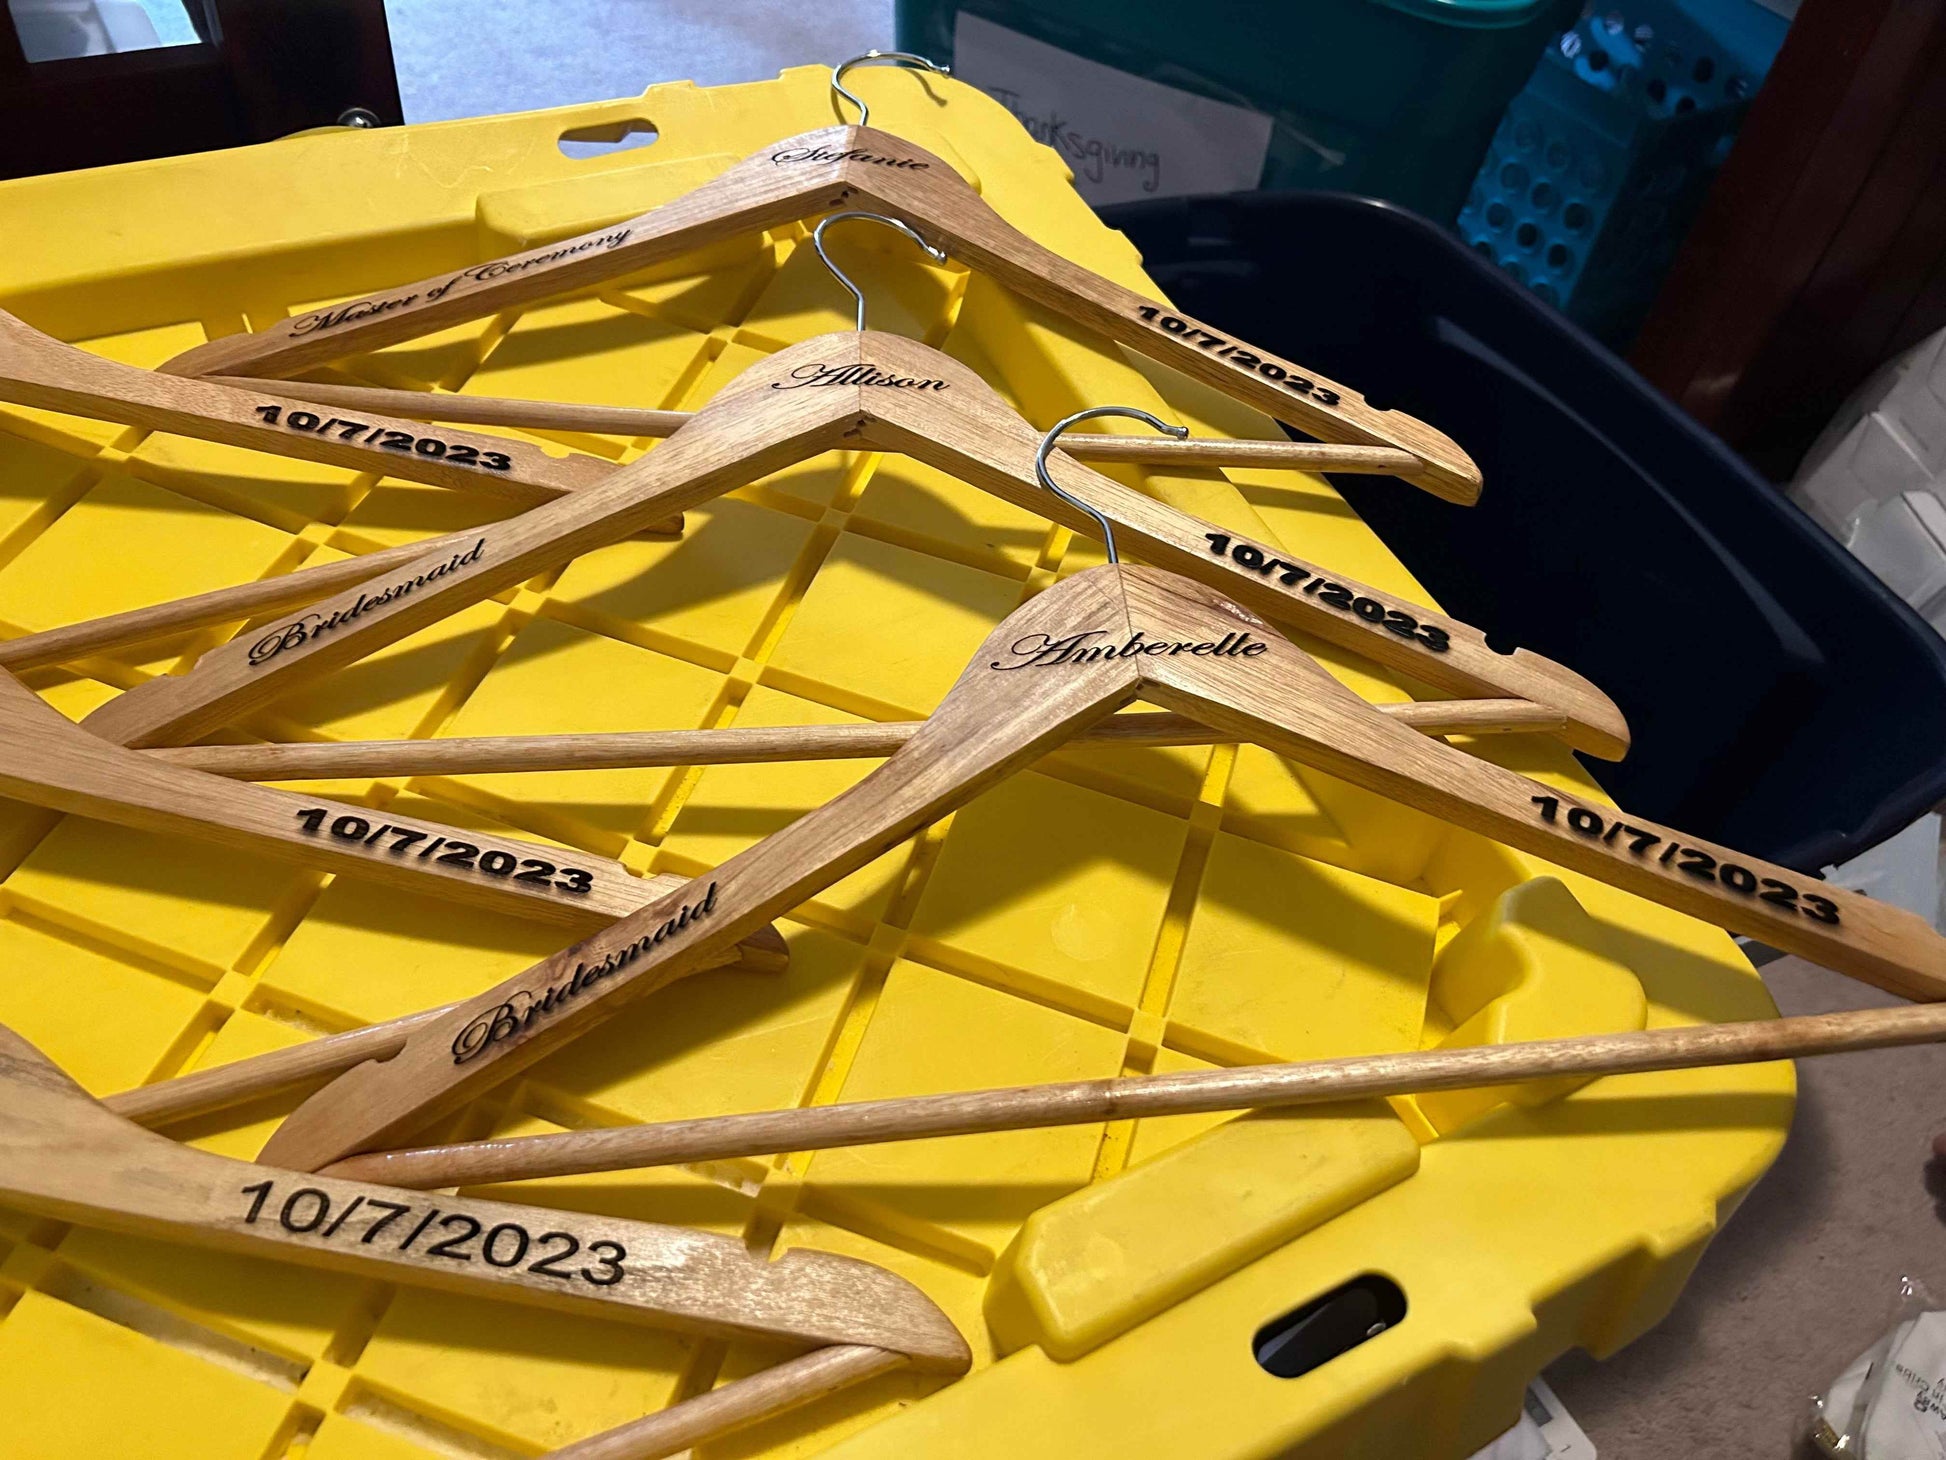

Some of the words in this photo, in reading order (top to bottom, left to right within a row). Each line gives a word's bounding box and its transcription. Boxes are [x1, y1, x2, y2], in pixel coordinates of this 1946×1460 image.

[772, 144, 930, 172] Stefanie
[288, 291, 419, 338] Master
[426, 274, 462, 302] of
[463, 226, 634, 282] Ceremony
[771, 363, 950, 392] Allison
[1138, 305, 1341, 407] 10/7/2023
[256, 404, 512, 472] 10/7/2023
[248, 538, 487, 667] Bridesmaid
[1204, 532, 1451, 653] 10/7/2023
[990, 630, 1269, 671] Amberelle
[297, 807, 595, 895] 10/7/2023
[1531, 795, 1841, 926] 10/7/2023
[451, 880, 719, 1066] Bridesmaid
[241, 1179, 628, 1287] 10/7/2023
